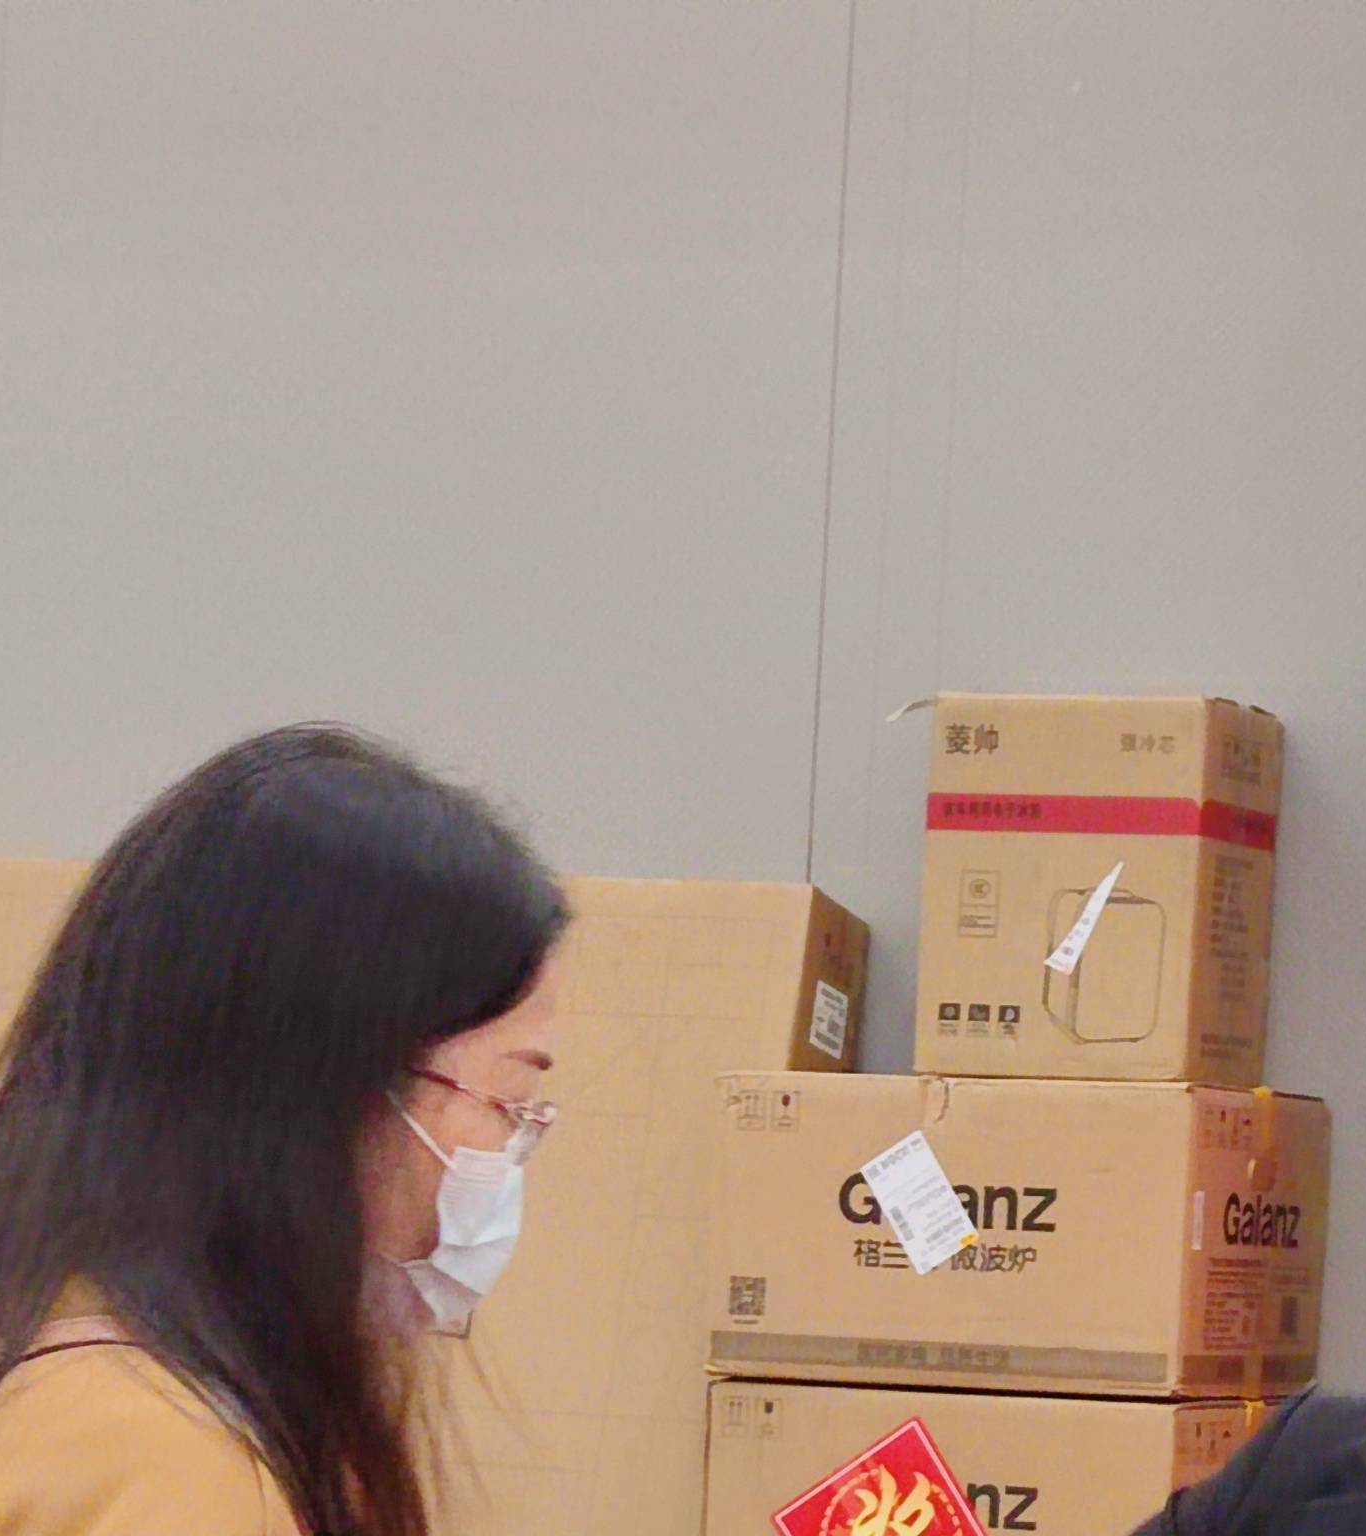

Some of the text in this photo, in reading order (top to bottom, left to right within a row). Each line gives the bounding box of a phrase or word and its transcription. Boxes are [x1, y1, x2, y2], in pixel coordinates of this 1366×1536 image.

[838, 1171, 1058, 1233] Ganz
[1222, 1191, 1302, 1249] Galanz
[853, 1238, 1038, 1274] 格兰微波炉
